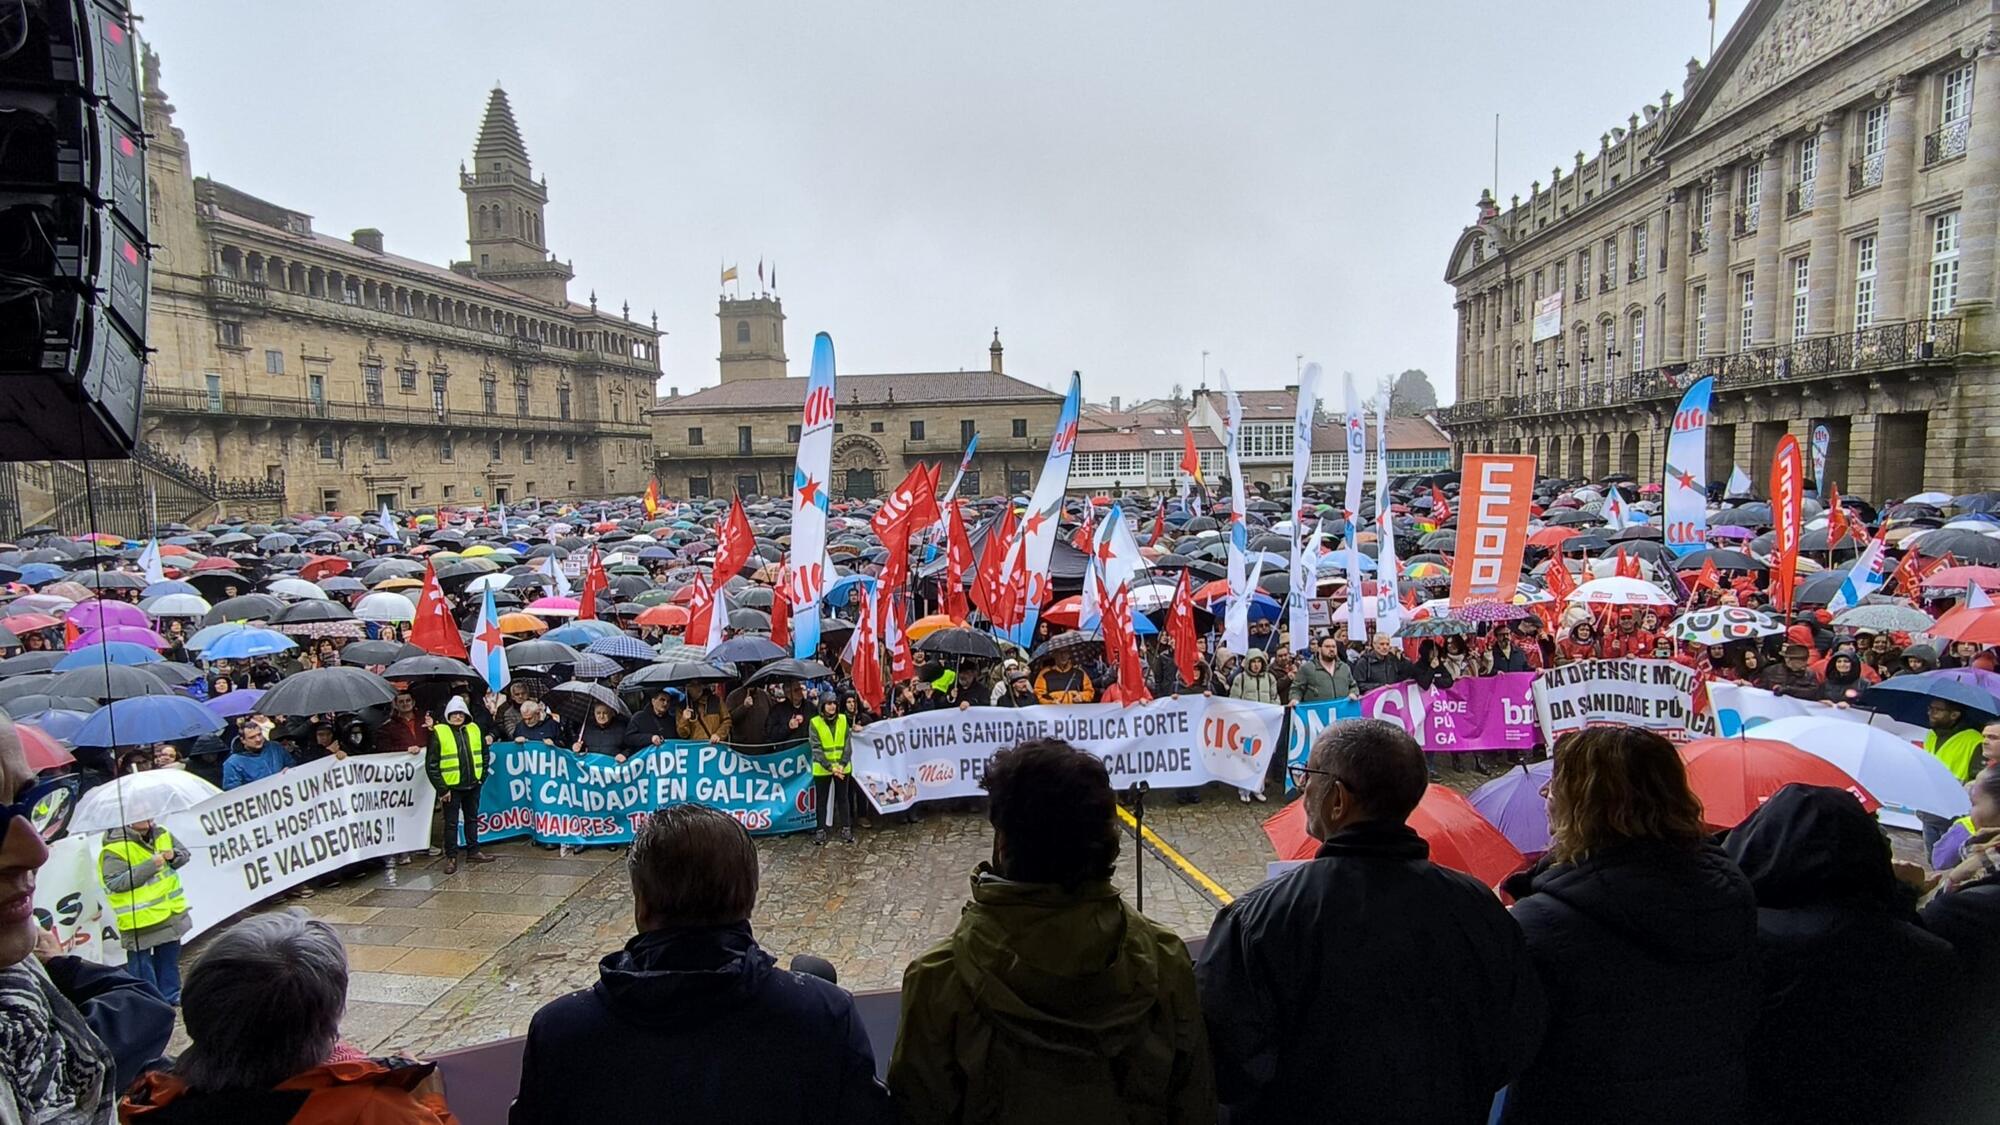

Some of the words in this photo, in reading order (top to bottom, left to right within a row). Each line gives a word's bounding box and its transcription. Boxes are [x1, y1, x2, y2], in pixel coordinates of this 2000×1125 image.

[1470, 462, 1514, 585] CCOO
[1545, 668, 1566, 691] NA
[1640, 664, 1648, 685] E
[1550, 699, 1577, 721] DA
[1578, 693, 1650, 718] SANIDADE
[873, 729, 907, 760] POR
[909, 724, 957, 750] UNHA
[962, 719, 1048, 748] SANIDADE
[1054, 714, 1128, 741] PÚBLICA
[1134, 711, 1189, 737] FORTE
[506, 750, 570, 781] UNHA
[576, 748, 689, 789] SANIDADE
[1104, 747, 1192, 776] CALIDADE
[199, 785, 293, 836] QUEREMOS
[297, 775, 320, 802] UN
[509, 777, 532, 802] DE
[539, 778, 649, 813] CALIDADE
[656, 776, 687, 805] EN
[695, 775, 787, 804] GALIZA
[209, 833, 253, 867] PARA
[253, 825, 273, 850] EL
[276, 797, 348, 841] HOSPITAL
[351, 788, 415, 814] COMARCAL
[477, 806, 534, 834] SOMO
[244, 856, 273, 891] DE
[274, 819, 383, 876] VALDEORRAS
